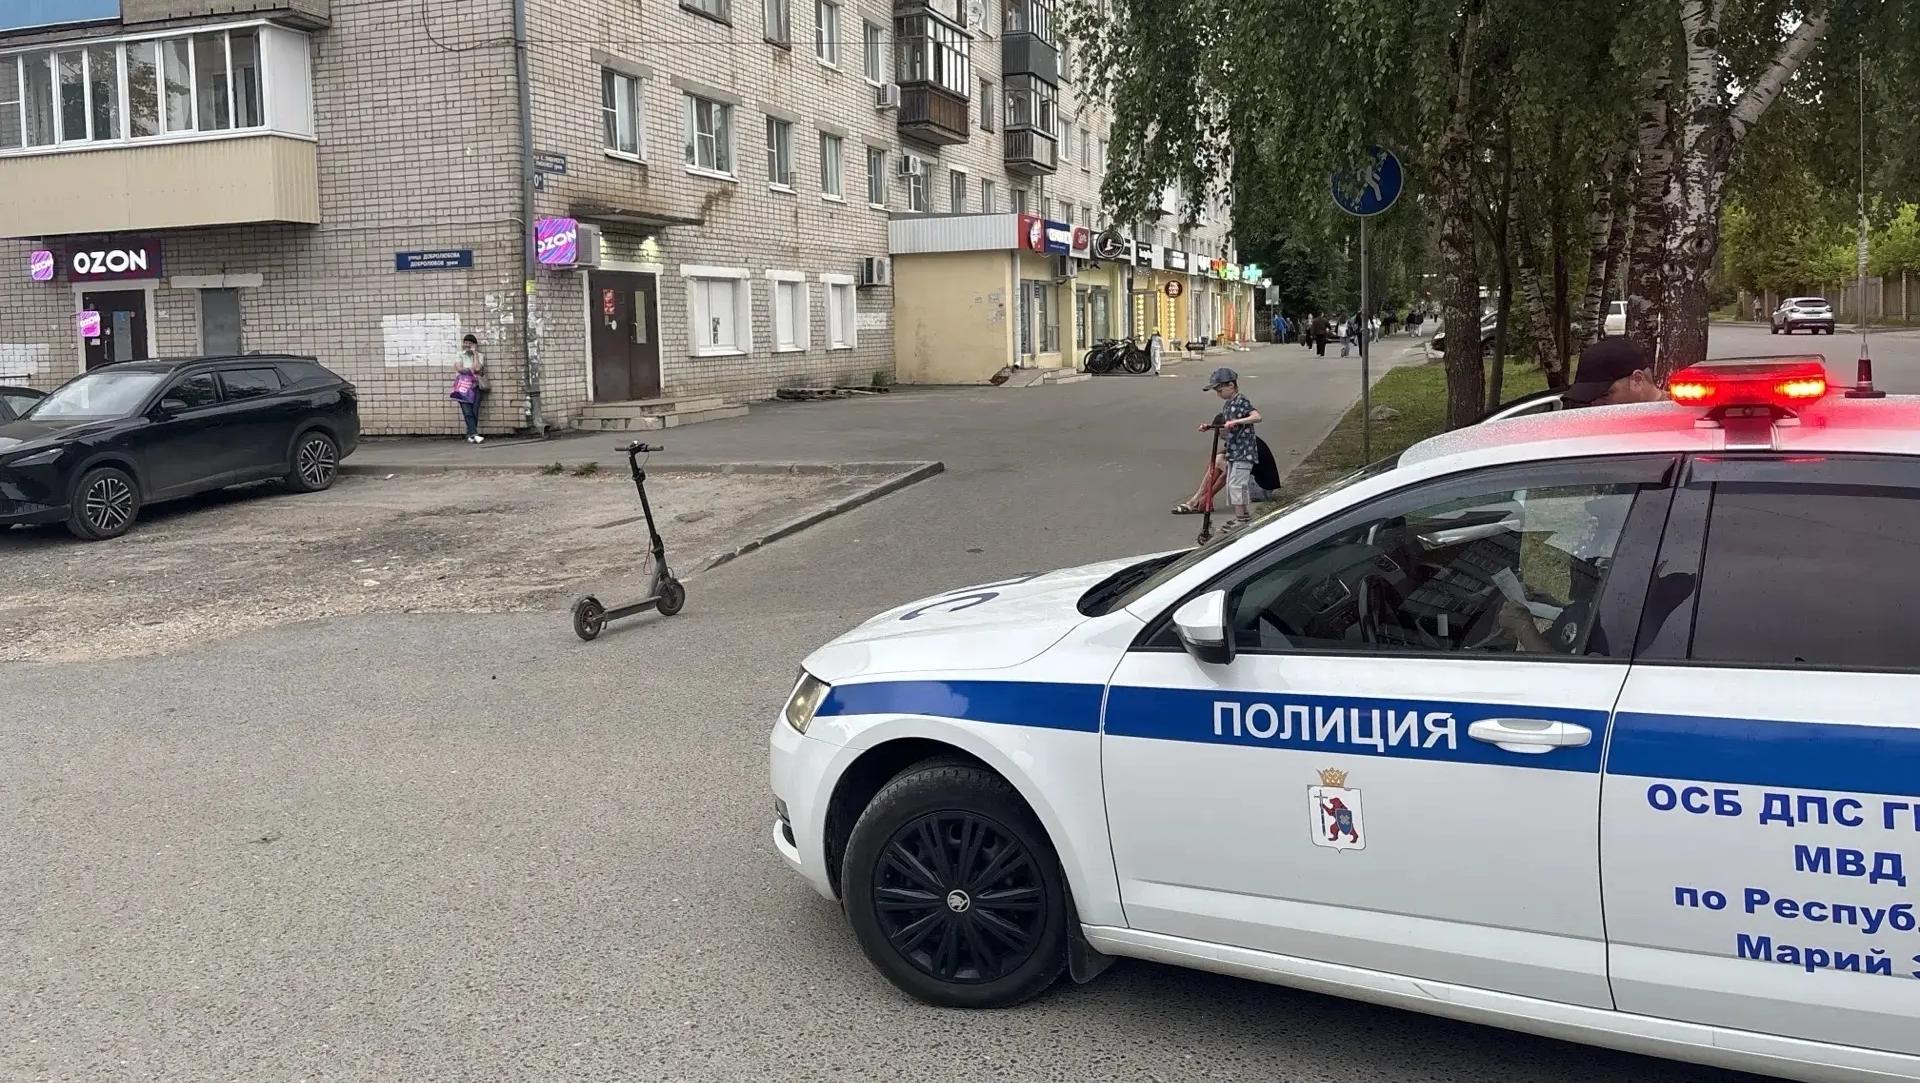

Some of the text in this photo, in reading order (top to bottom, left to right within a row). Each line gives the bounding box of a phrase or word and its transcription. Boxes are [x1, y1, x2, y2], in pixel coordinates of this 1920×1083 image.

[73, 249, 147, 274] OZON
[1213, 701, 1457, 752] ПОЛИЦИЯ
[1647, 784, 1920, 832] ОСБ ДПС Г
[1794, 844, 1906, 887] МВД
[1675, 887, 1920, 935] по Респуб
[1736, 933, 1892, 976] Марий
